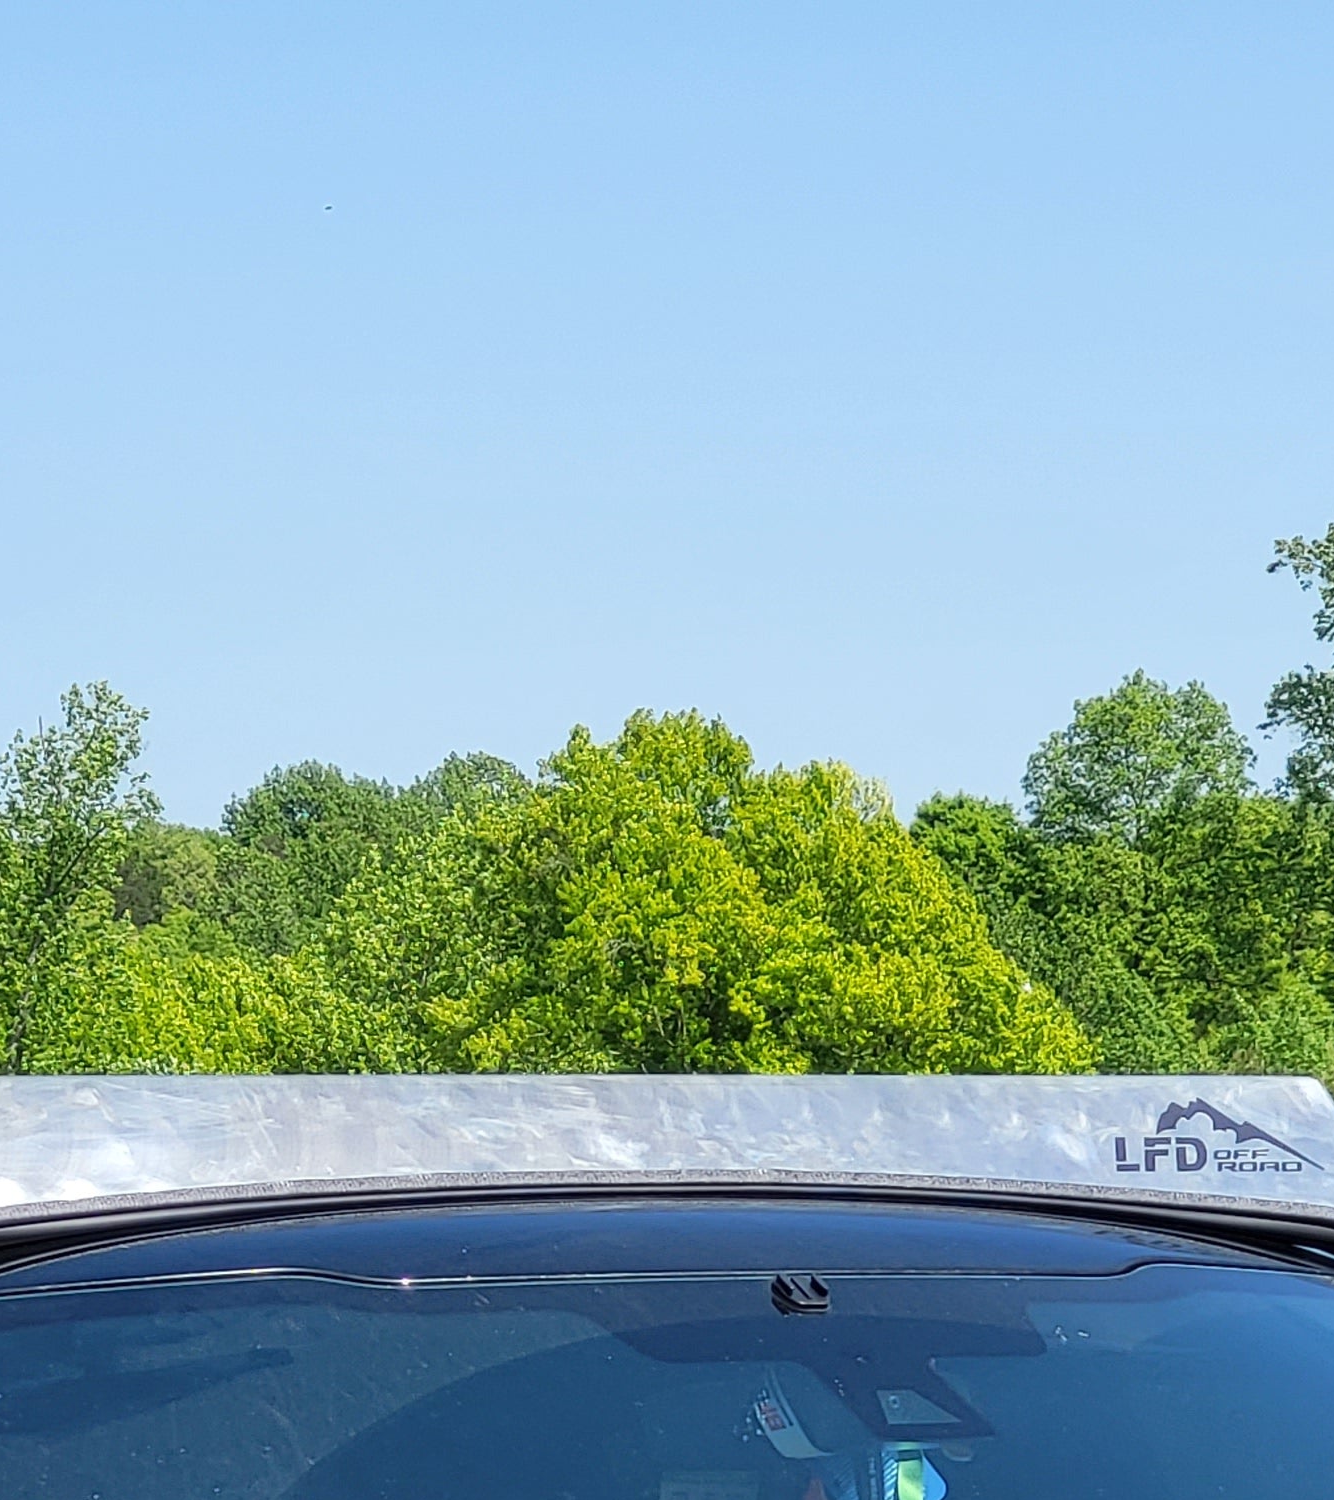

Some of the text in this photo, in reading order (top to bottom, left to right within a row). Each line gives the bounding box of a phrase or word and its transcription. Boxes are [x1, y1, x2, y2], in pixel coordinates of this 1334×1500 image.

[1115, 1136, 1208, 1173] LFD
[1213, 1148, 1270, 1161] OFF
[1217, 1161, 1303, 1173] ROAD
